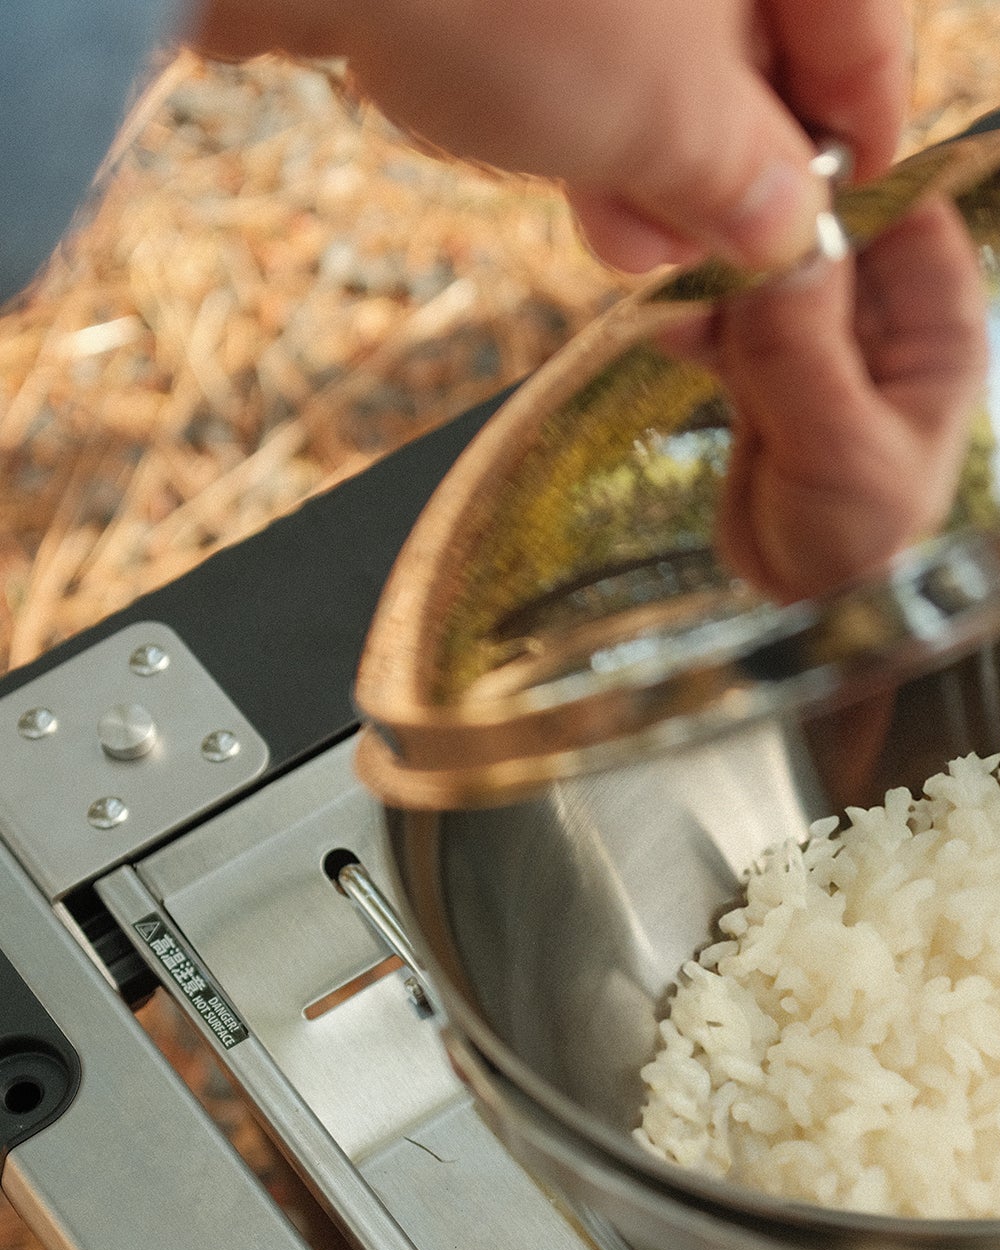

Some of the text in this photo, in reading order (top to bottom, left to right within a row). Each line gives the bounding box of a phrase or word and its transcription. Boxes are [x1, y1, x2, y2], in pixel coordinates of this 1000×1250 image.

[149, 933, 206, 997] 高温注意
[192, 995, 236, 1047] HOT SURFACE
[207, 996, 240, 1032] DANGER!
